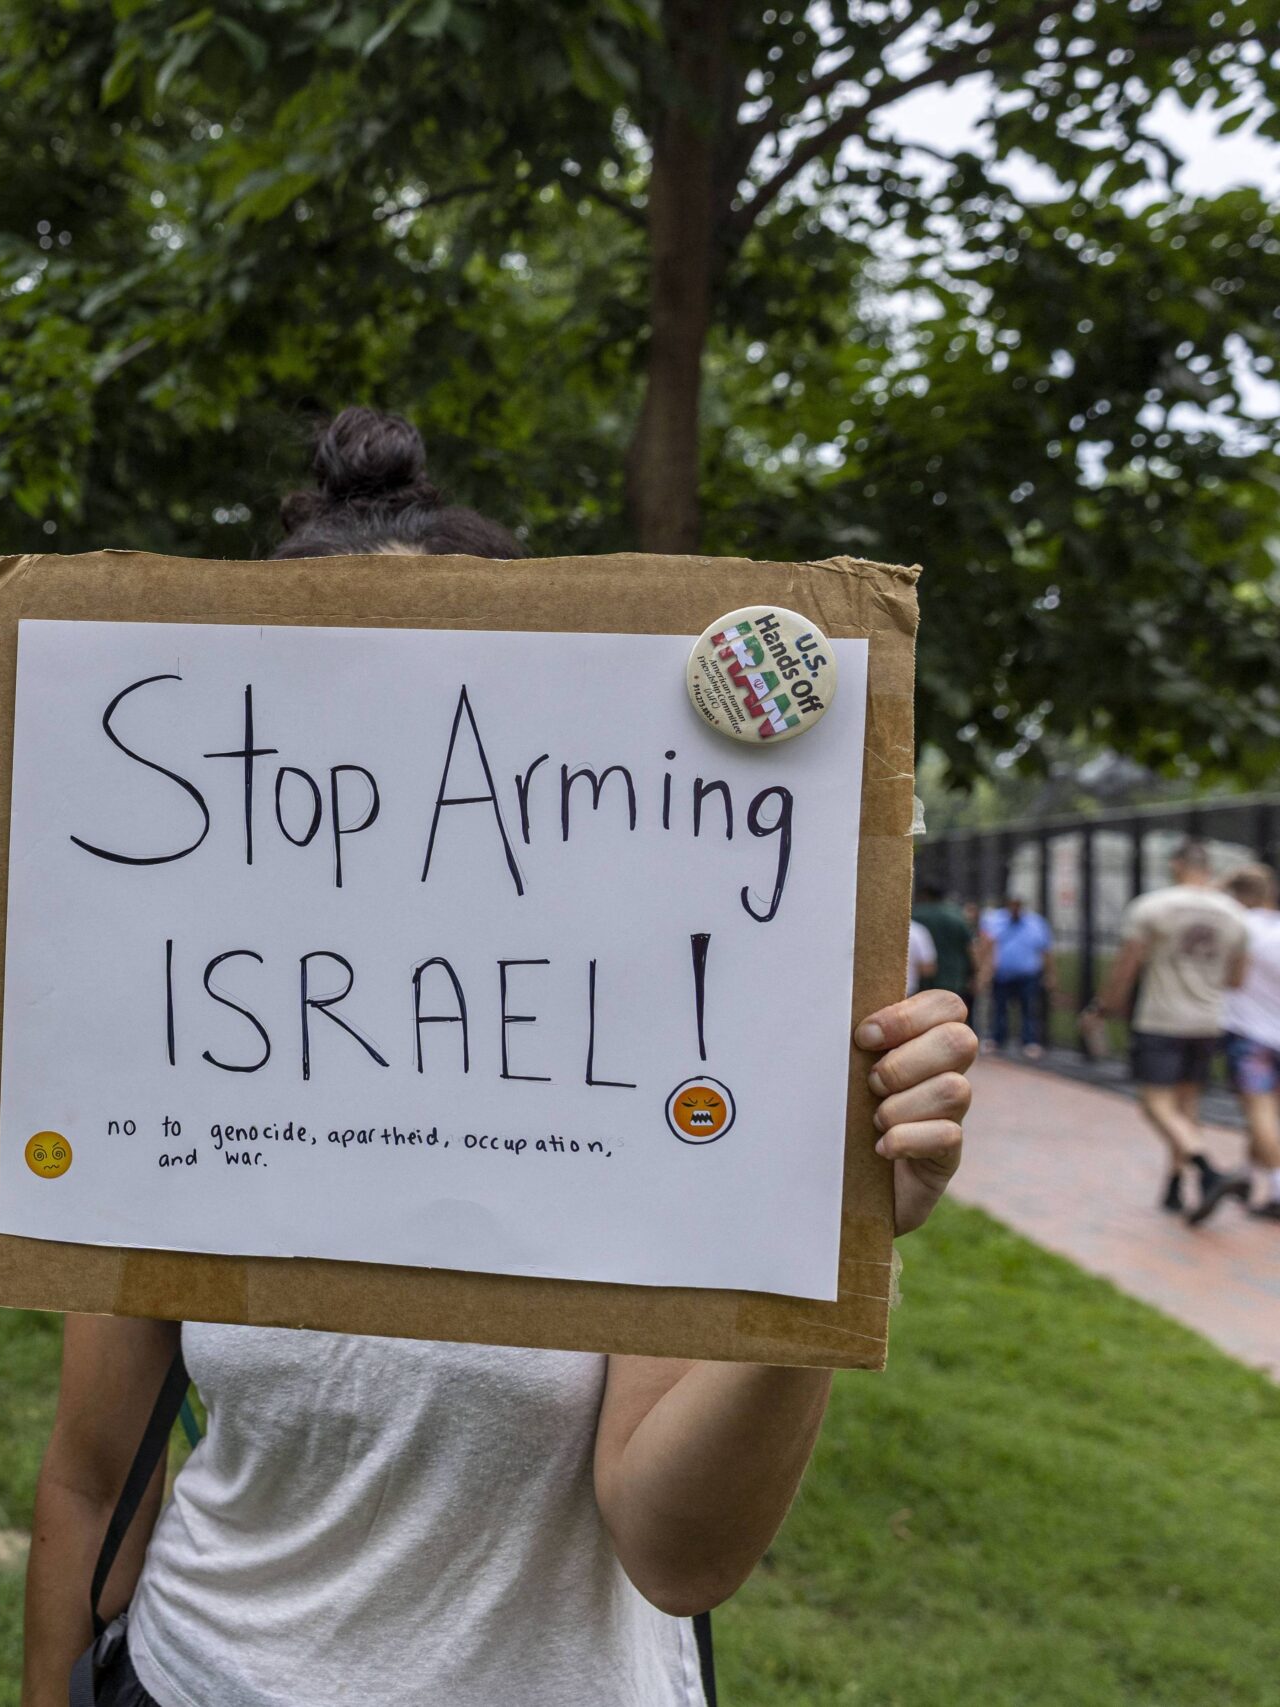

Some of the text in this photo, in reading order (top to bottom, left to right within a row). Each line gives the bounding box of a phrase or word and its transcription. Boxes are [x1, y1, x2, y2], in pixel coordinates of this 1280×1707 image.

[709, 659, 746, 722] American-Iranian
[711, 620, 801, 738] IRAN
[755, 613, 824, 714] Hands Off
[795, 633, 827, 678] U.S.
[697, 655, 742, 735] Friendship Committee
[71, 675, 794, 923] Stop Arming
[108, 1116, 611, 1157] no to genocide, apartheid, occupation,
[159, 1149, 267, 1167] and war.
